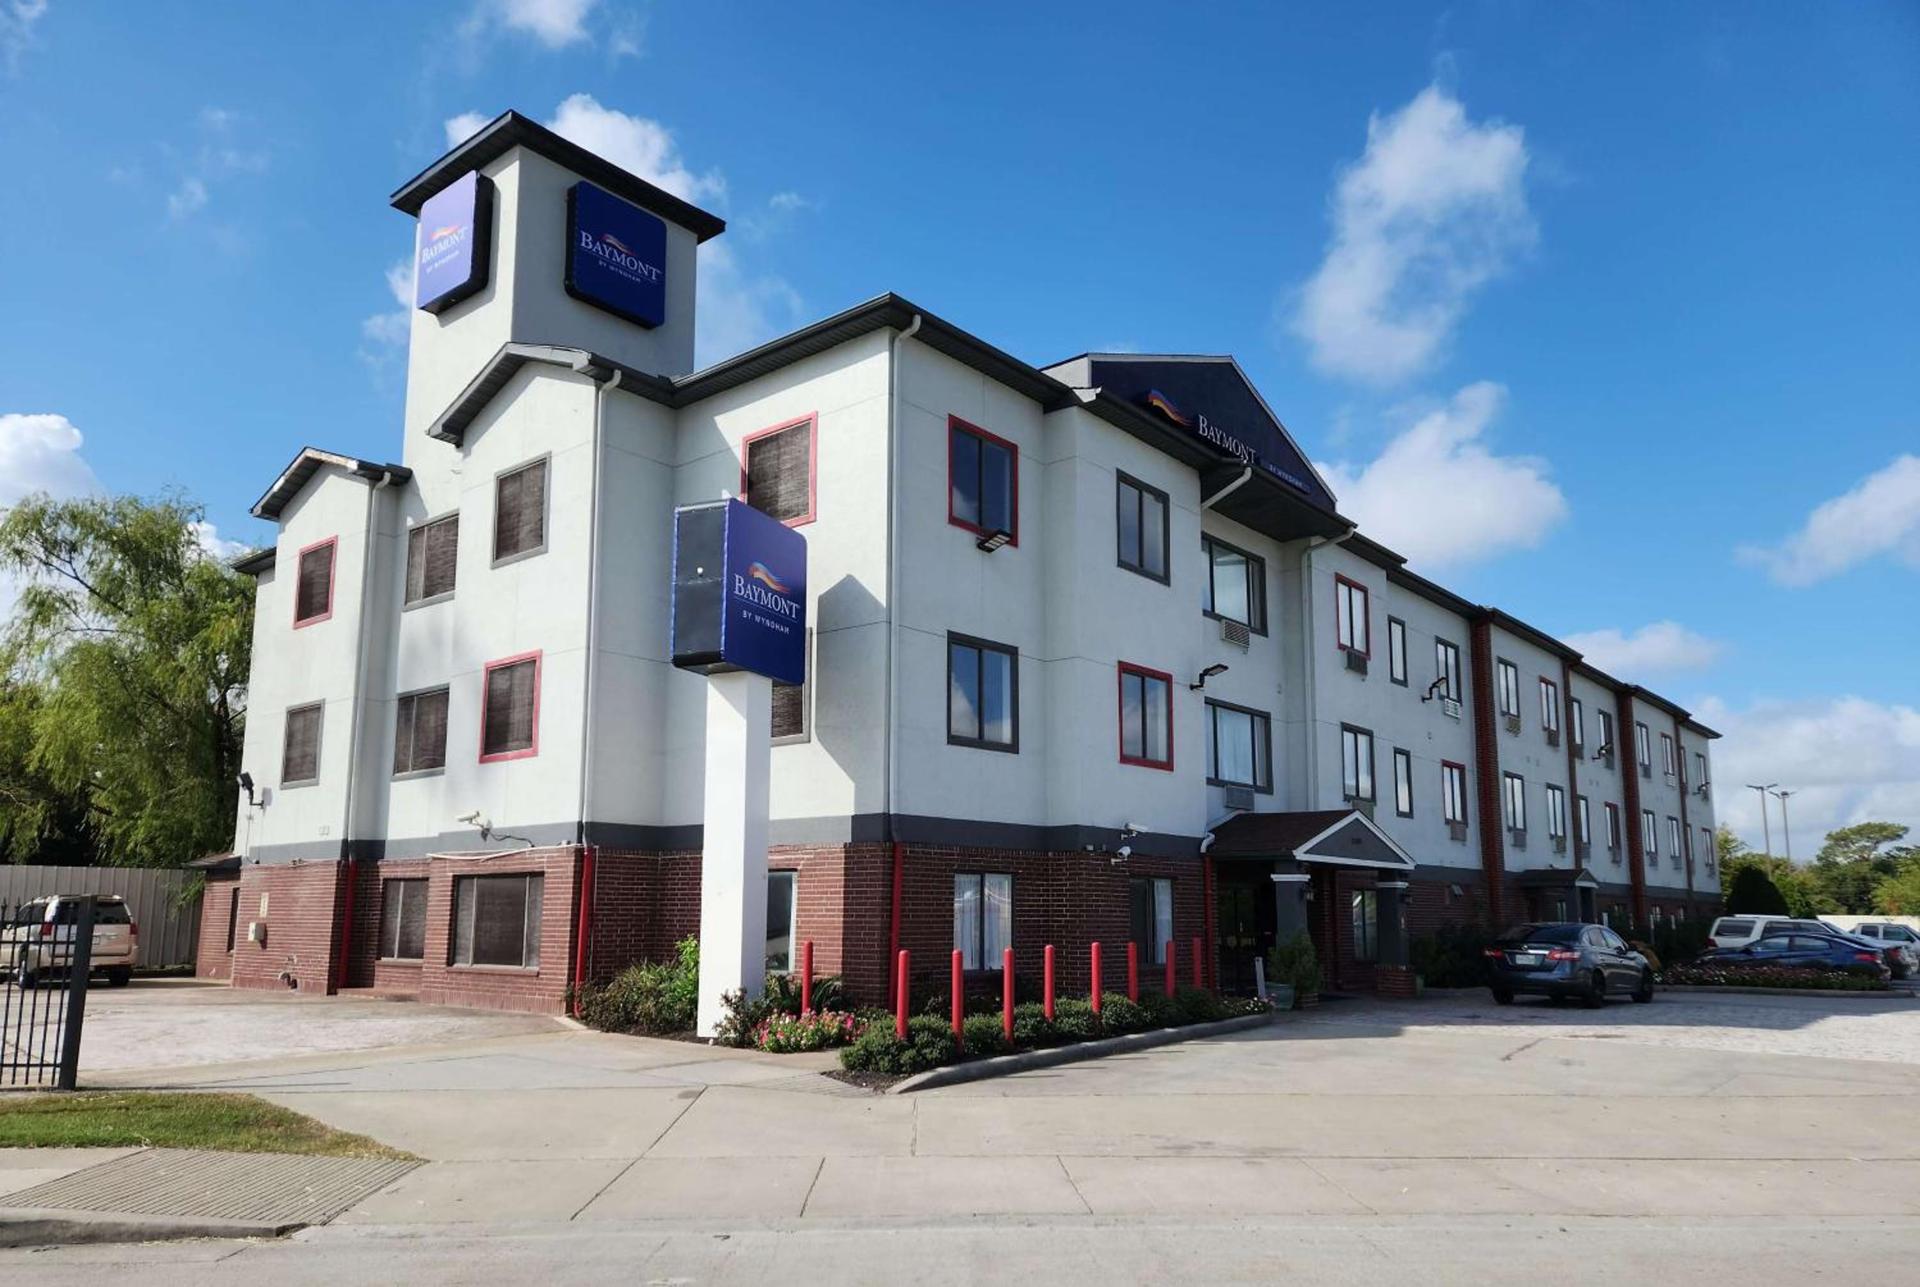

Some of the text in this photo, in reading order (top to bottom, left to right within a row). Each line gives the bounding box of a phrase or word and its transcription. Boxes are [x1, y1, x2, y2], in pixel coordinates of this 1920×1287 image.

[422, 227, 467, 263] BAYMONT
[580, 230, 662, 280] BAYMONT
[1198, 413, 1256, 464] BAYMONT
[734, 573, 800, 619] BAYMONT
[742, 609, 790, 635] BY WYNDHAM
